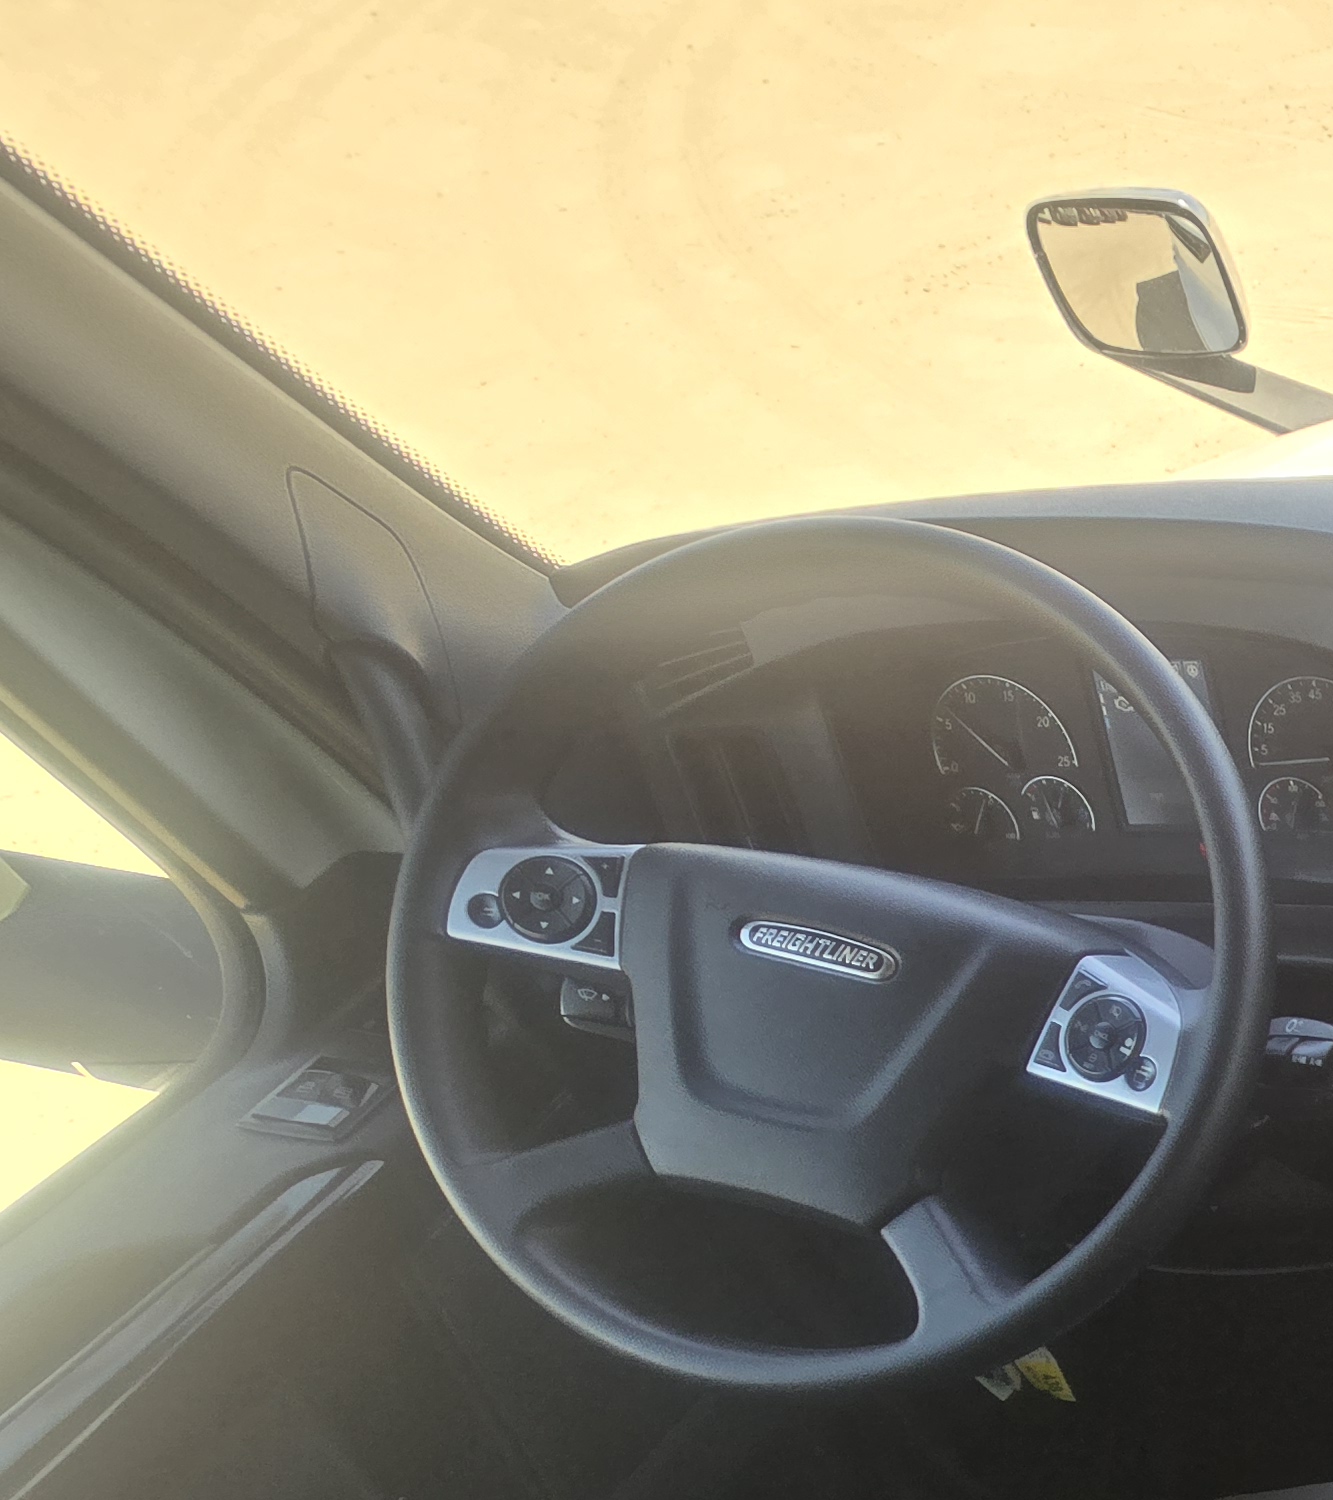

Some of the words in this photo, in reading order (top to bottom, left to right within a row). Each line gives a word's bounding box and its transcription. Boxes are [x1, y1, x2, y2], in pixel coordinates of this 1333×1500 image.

[964, 693, 975, 704] 10
[1003, 691, 1014, 702] 15
[1289, 691, 1302, 703] 35
[1308, 689, 1322, 700] 45
[1273, 704, 1286, 716] 25
[945, 719, 952, 730] 5
[1036, 716, 1050, 728] 20
[1263, 722, 1275, 734] 15
[1261, 744, 1268, 755] 5
[1058, 756, 1070, 767] 25
[751, 926, 879, 971] FREIGHTLINER
